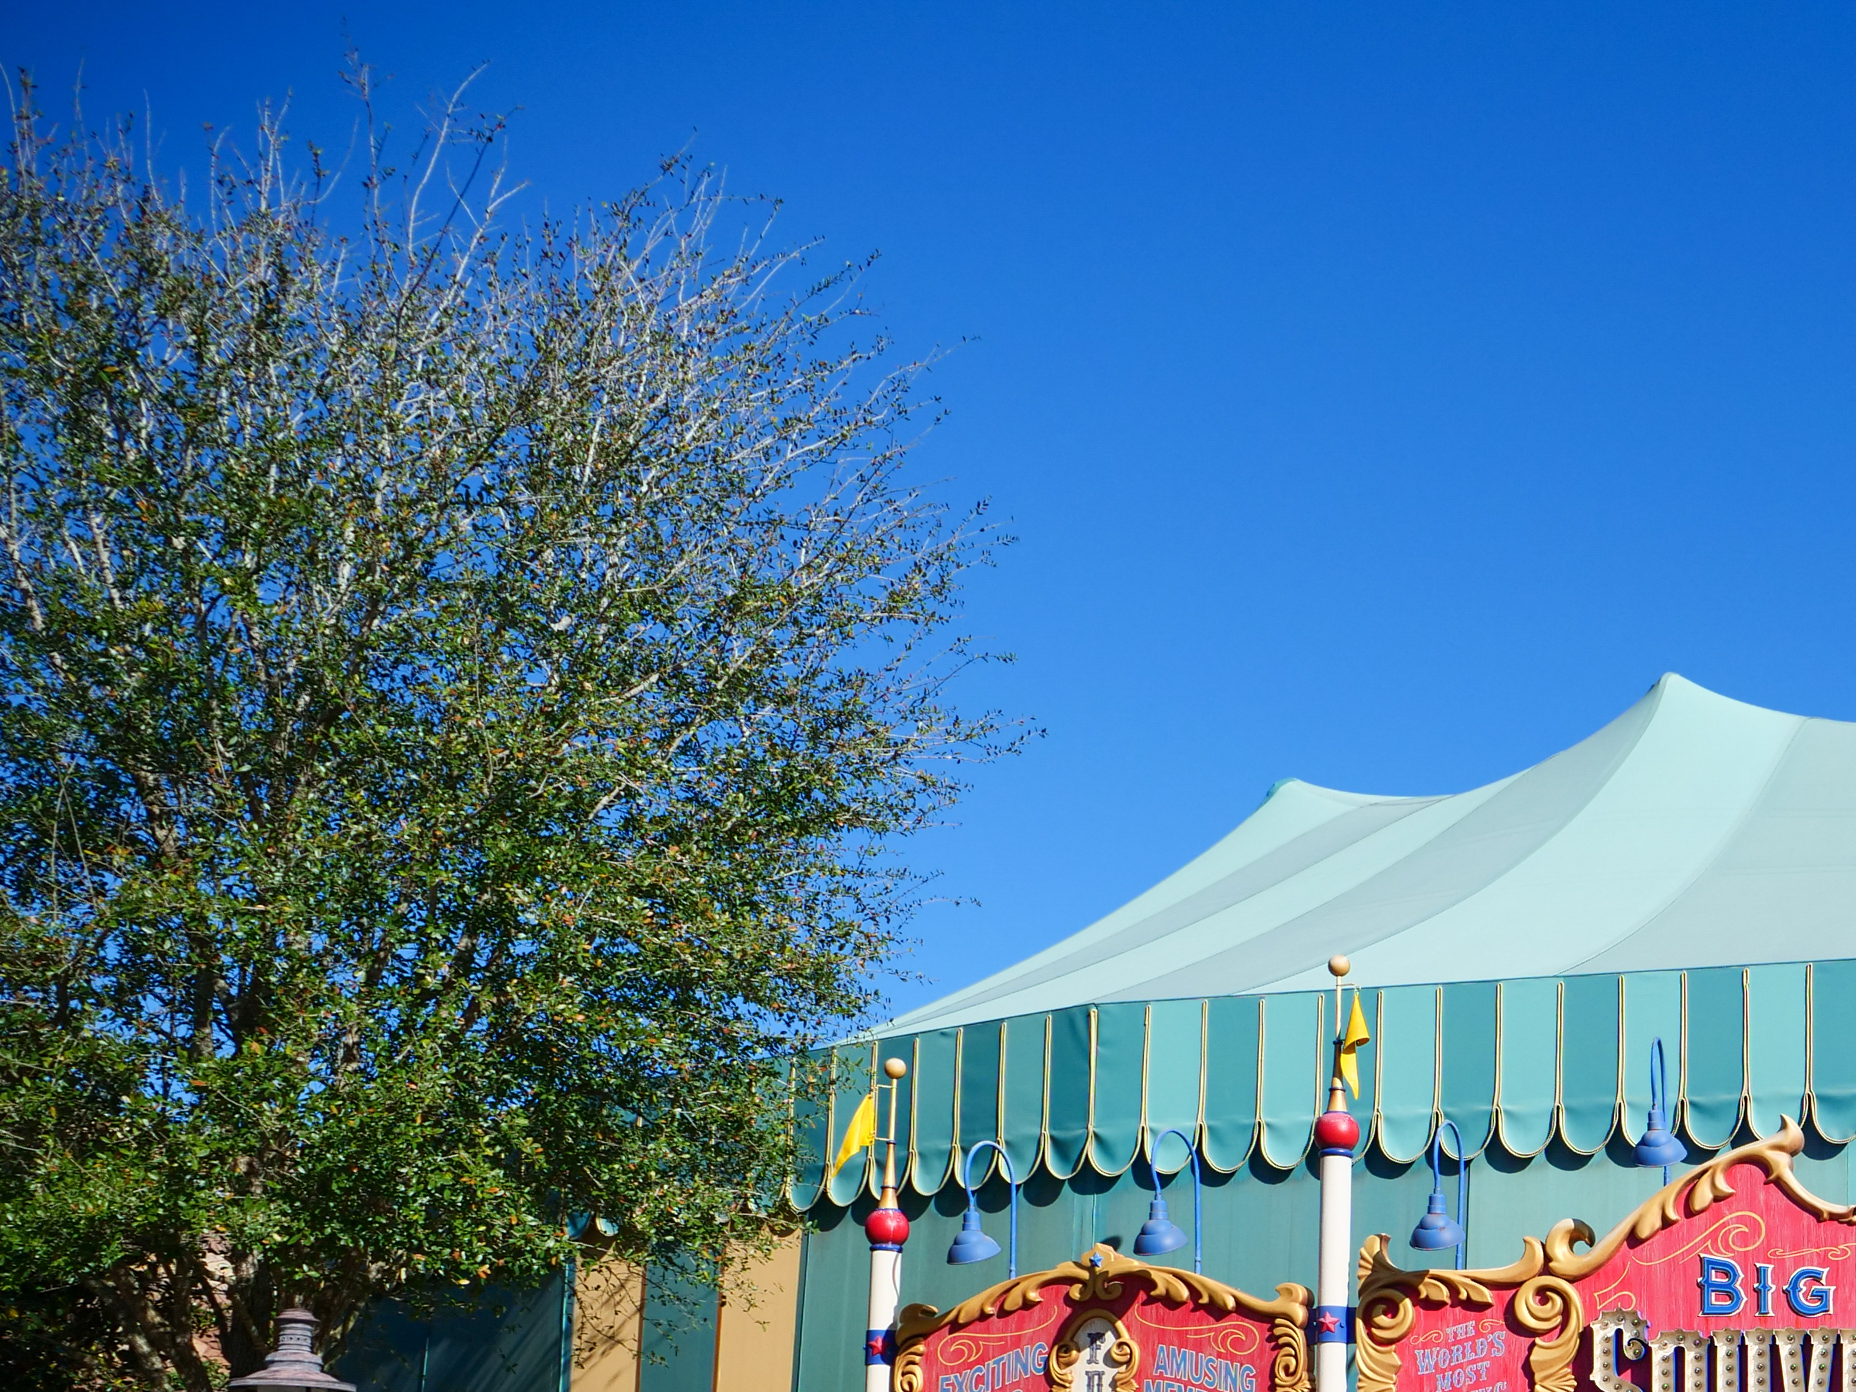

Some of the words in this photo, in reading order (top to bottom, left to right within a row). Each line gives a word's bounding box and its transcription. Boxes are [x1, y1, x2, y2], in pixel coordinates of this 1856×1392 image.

[1698, 1254, 1836, 1317] BIG
[1414, 1330, 1506, 1375] WORLD'S
[1446, 1320, 1475, 1342] THE
